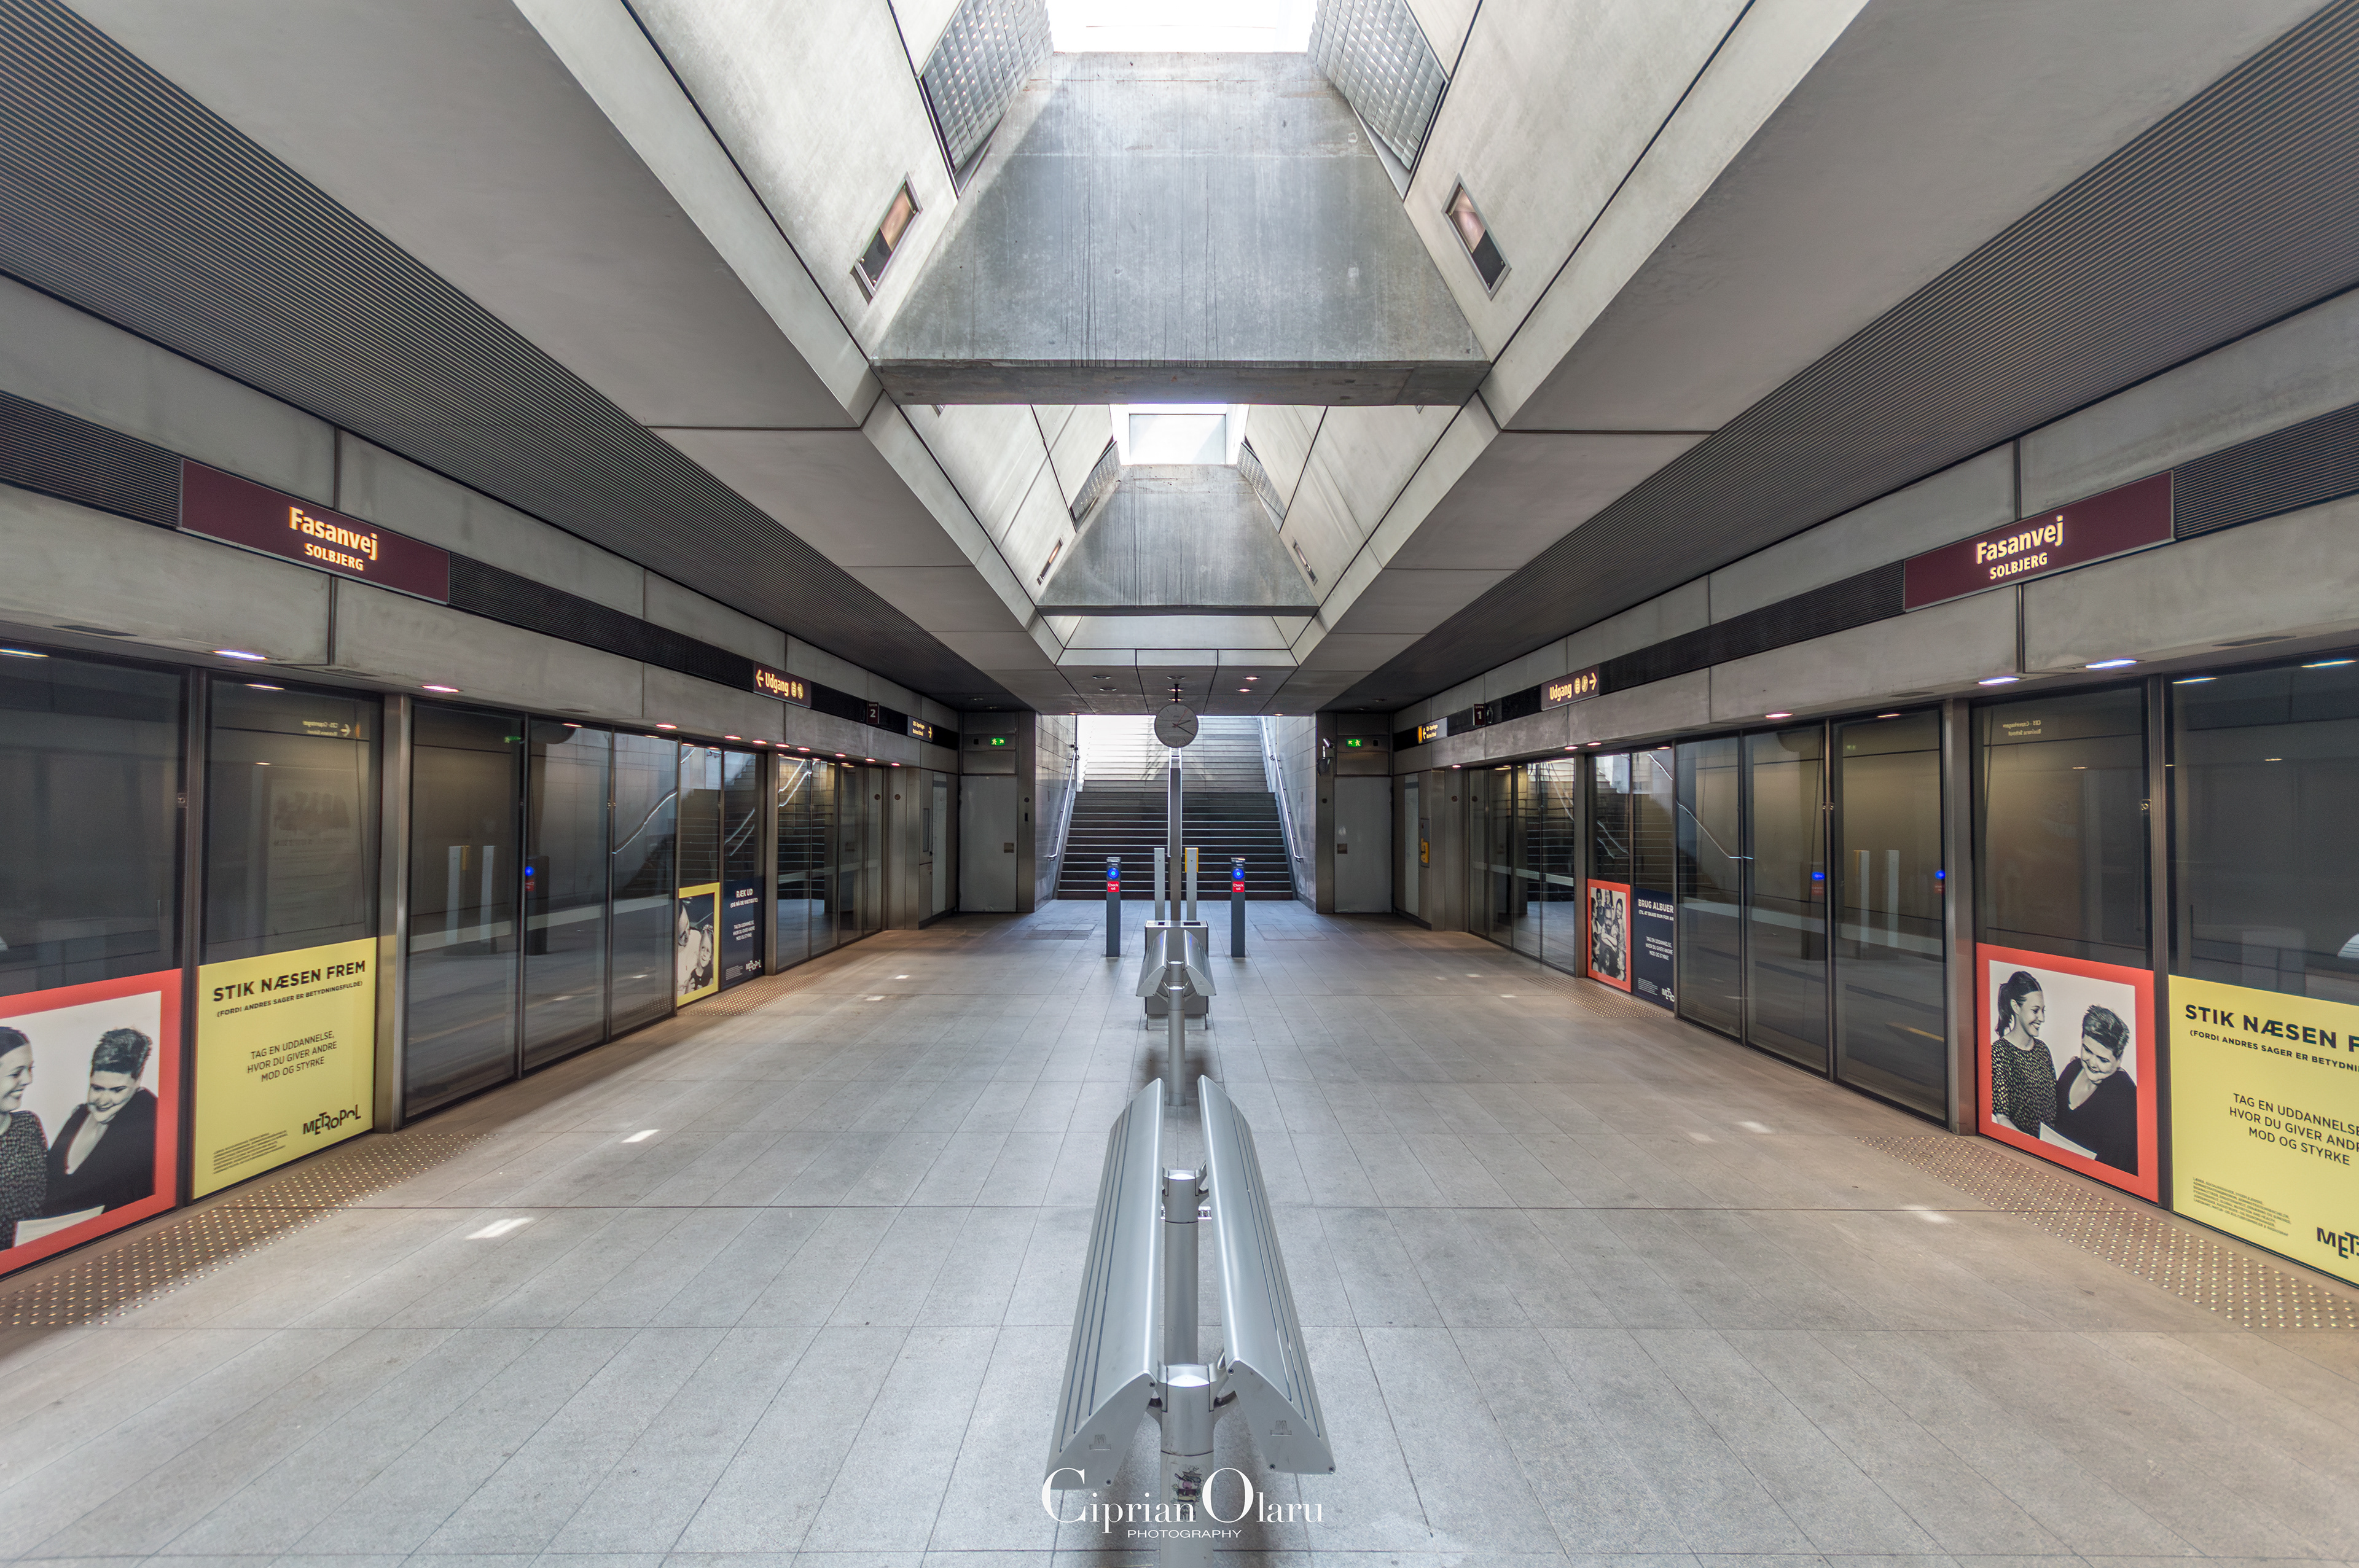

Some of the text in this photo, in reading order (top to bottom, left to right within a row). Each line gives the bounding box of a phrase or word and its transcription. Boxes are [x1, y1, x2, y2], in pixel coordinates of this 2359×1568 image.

[289, 506, 378, 561] Fasanvej
[1975, 515, 2064, 564] Fasanvej
[304, 542, 364, 571] SOLBJERG
[1989, 552, 2048, 580] SOLBJERG
[765, 672, 790, 697] Udgang
[1549, 683, 1572, 702] Udgang
[870, 709, 876, 718] 2
[1477, 711, 1482, 720] 1
[1638, 899, 1675, 913] BRUG ALBUER
[213, 960, 366, 1002] STIK NÆSEN FREM
[217, 1006, 242, 1017] (FORDI
[245, 1000, 272, 1011] ANDRES
[273, 995, 294, 1005] SAGER
[2185, 1004, 2234, 1028] STIK
[2243, 1015, 2337, 1049] NÆSEN
[247, 1041, 337, 1074] HVOR DU GIVER ANDRE
[251, 1031, 335, 1059] TAG EN UDDANNELSE,
[2189, 1029, 2359, 1073] (FORDI ANDRES SAGER ER BETYDNI
[261, 1056, 325, 1082] MOD OG STYRKE
[2233, 1093, 2255, 1107] TAG
[2258, 1100, 2274, 1112] EN
[2229, 1107, 2261, 1124] HVOR
[2264, 1116, 2282, 1129] DU
[2285, 1123, 2322, 1141] GIVER
[2248, 1127, 2350, 1166] MOD OG STYRKE
[2317, 1227, 2359, 1259] MET
